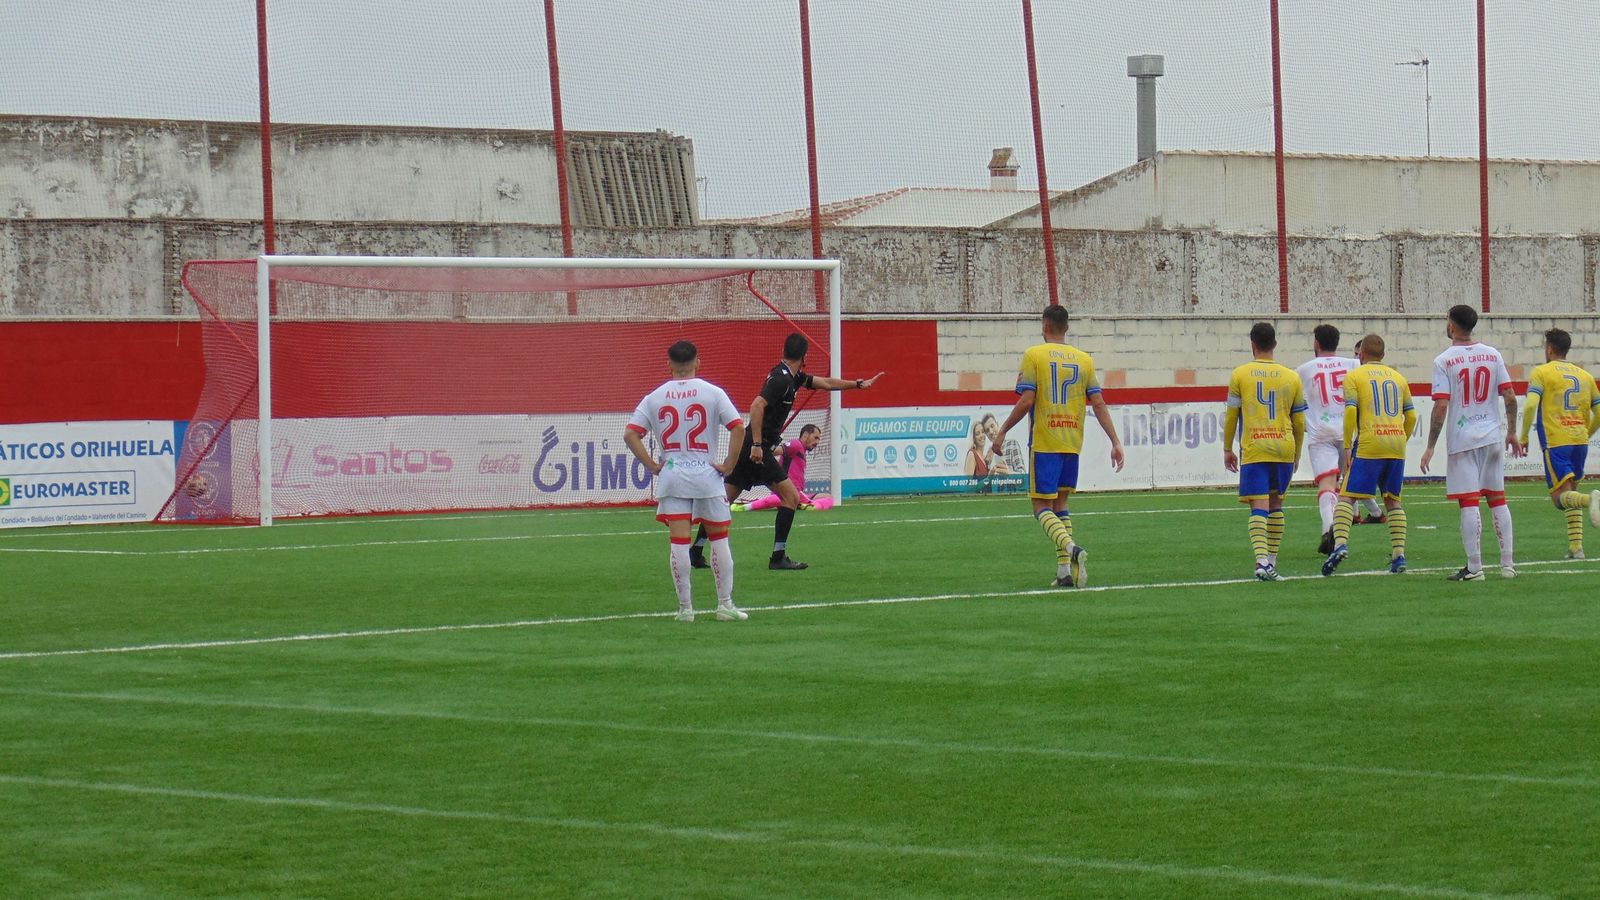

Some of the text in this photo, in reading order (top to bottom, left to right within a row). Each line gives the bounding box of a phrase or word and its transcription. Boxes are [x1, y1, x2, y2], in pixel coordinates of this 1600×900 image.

[1446, 354, 1498, 368] MANU CRUZADO
[1049, 361, 1079, 404] 17
[1256, 381, 1275, 420] 4
[1312, 369, 1348, 408] 15
[1370, 379, 1398, 417] 10
[1457, 366, 1491, 408] 10
[1562, 374, 1579, 410] 2
[658, 403, 709, 453] 22
[857, 419, 964, 436] JUGAMOS EN EQUIPO
[70, 439, 174, 458] ORIHUELA
[313, 443, 454, 476] Santos
[13, 480, 130, 499] EUROMASTER
